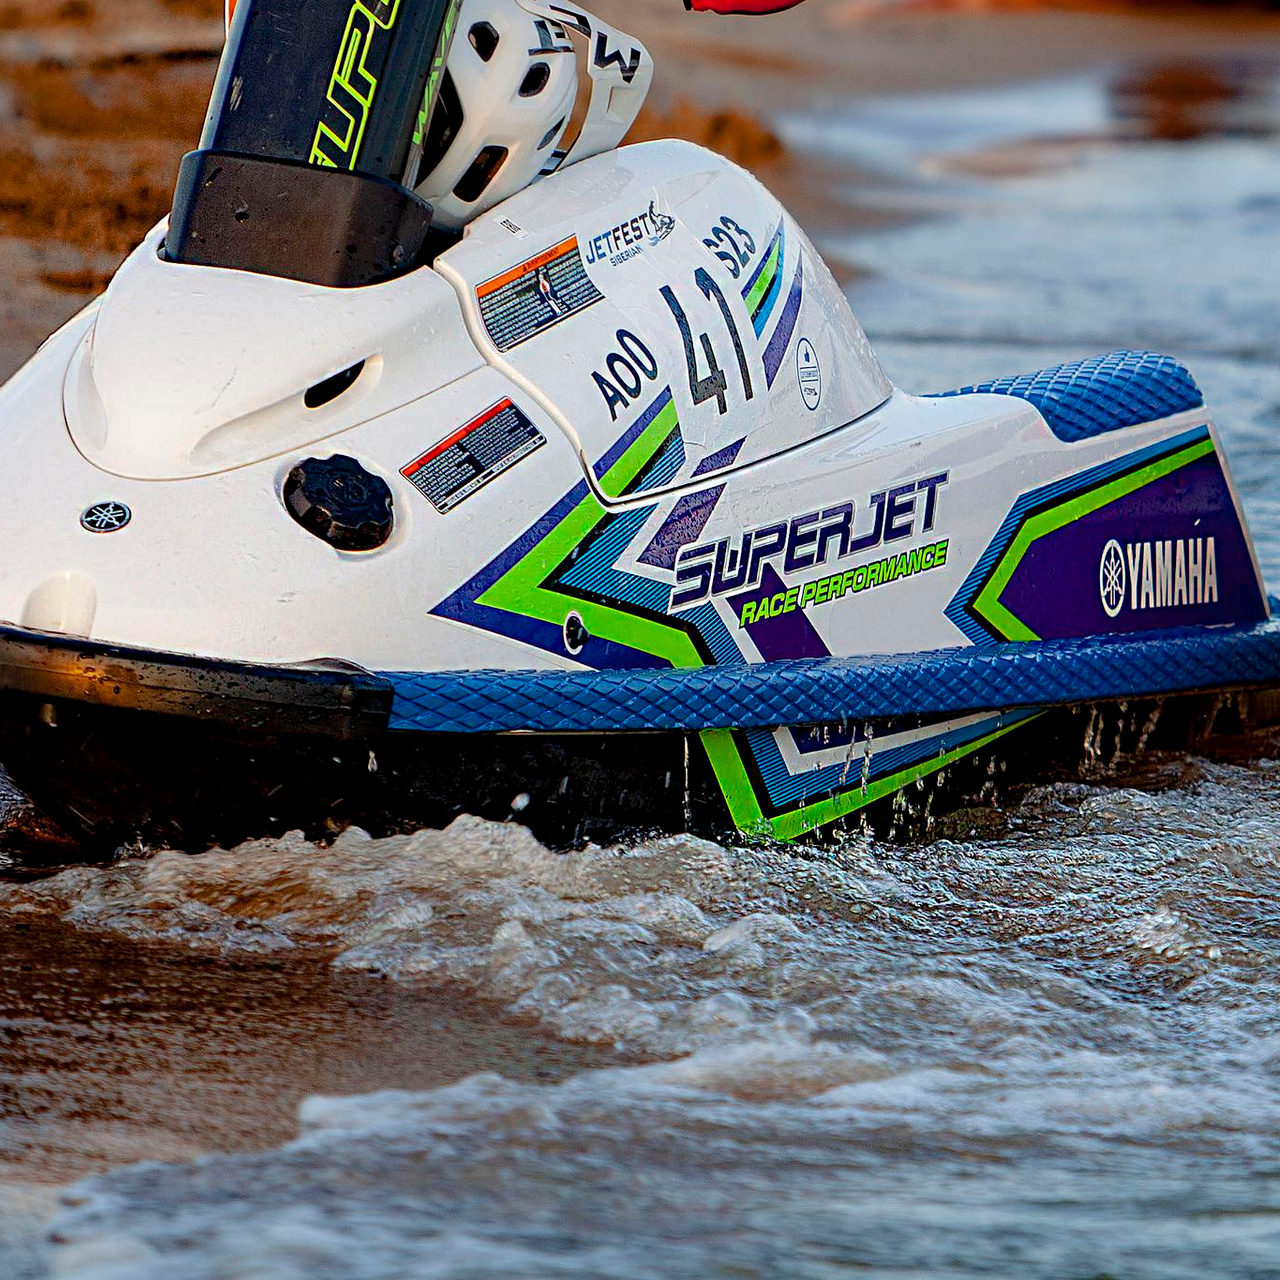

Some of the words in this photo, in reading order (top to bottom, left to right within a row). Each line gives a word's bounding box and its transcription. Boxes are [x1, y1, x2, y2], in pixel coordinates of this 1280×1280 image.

[585, 213, 651, 264] JETFEST
[609, 245, 644, 267] SIBERIAN
[658, 266, 754, 415] 41
[670, 472, 949, 612] SUPERJET
[1127, 536, 1218, 610] YAMAHA
[739, 586, 801, 628] RACE
[800, 539, 950, 609] PERFORMANCE
